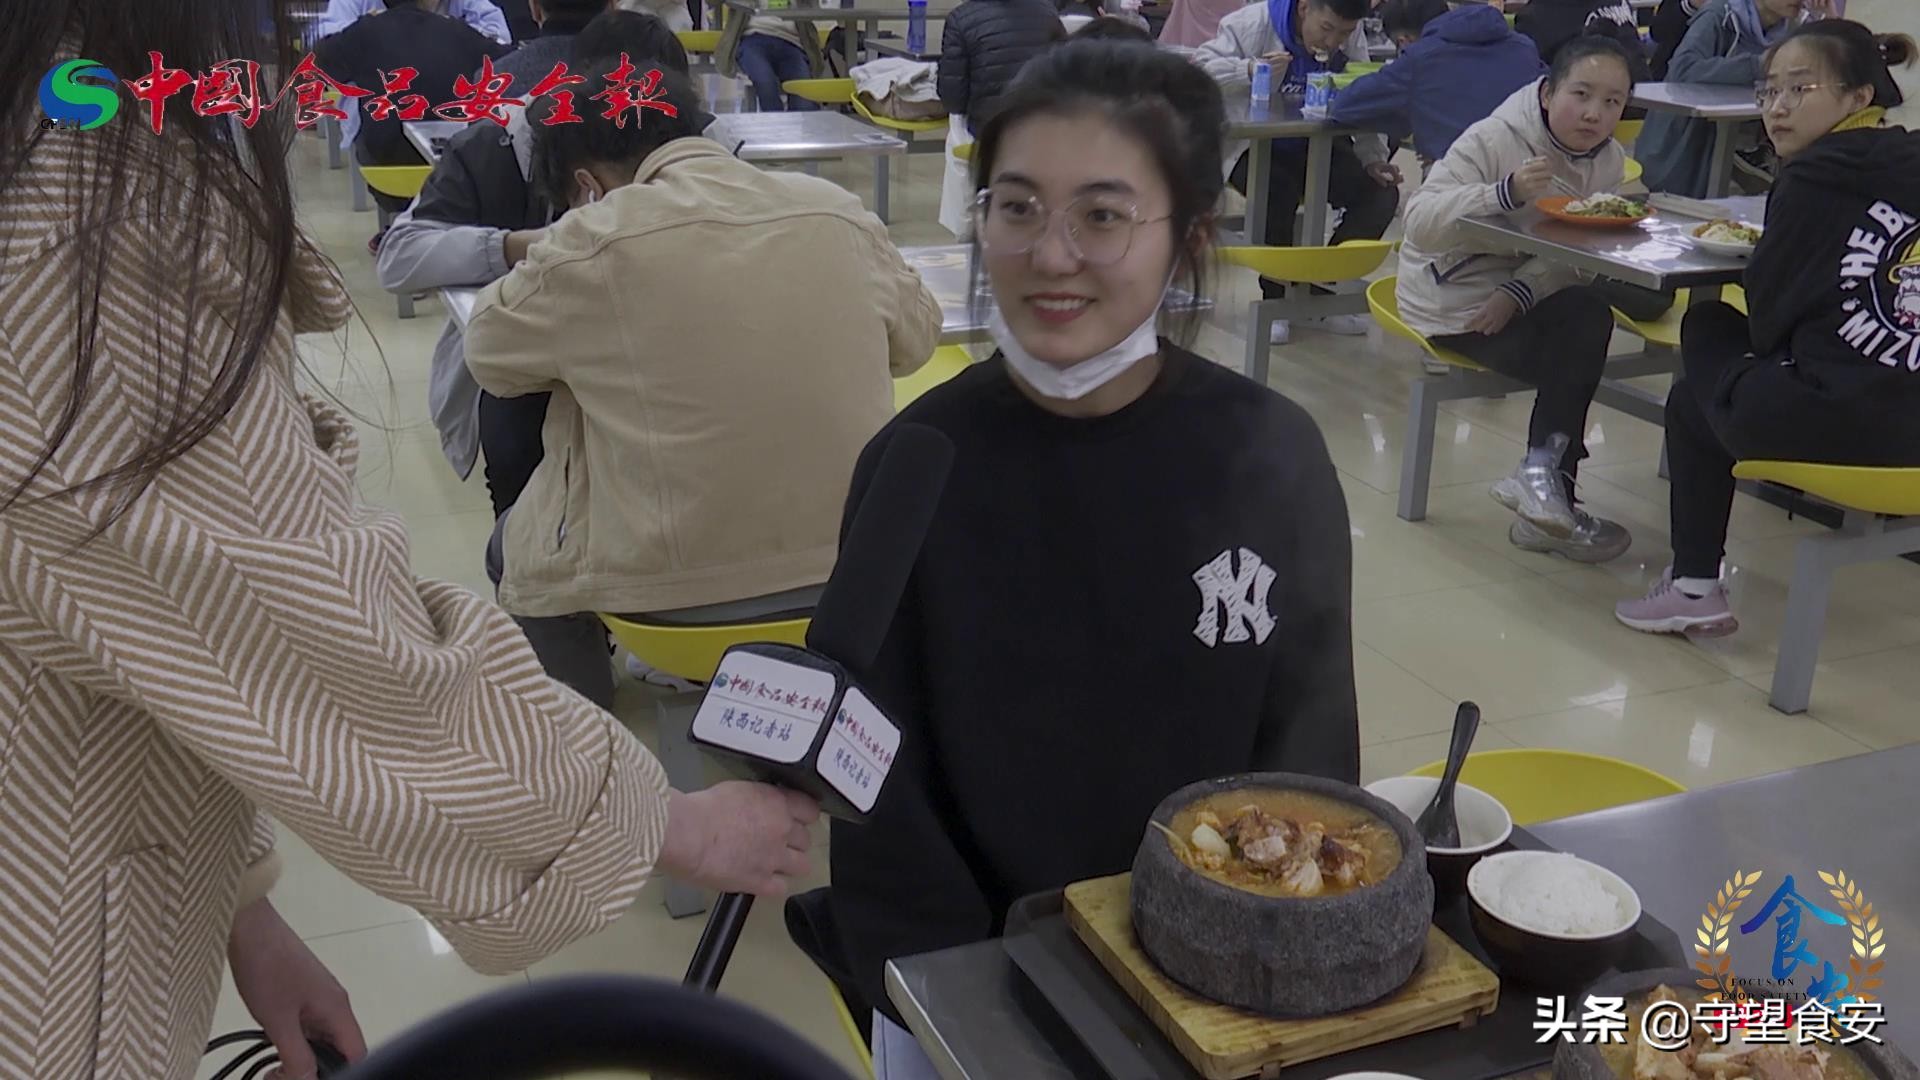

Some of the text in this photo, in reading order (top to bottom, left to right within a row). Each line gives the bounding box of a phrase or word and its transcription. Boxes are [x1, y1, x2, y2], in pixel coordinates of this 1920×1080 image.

[1192, 547, 1278, 648] NY
[719, 706, 793, 742] 陕西记者站
